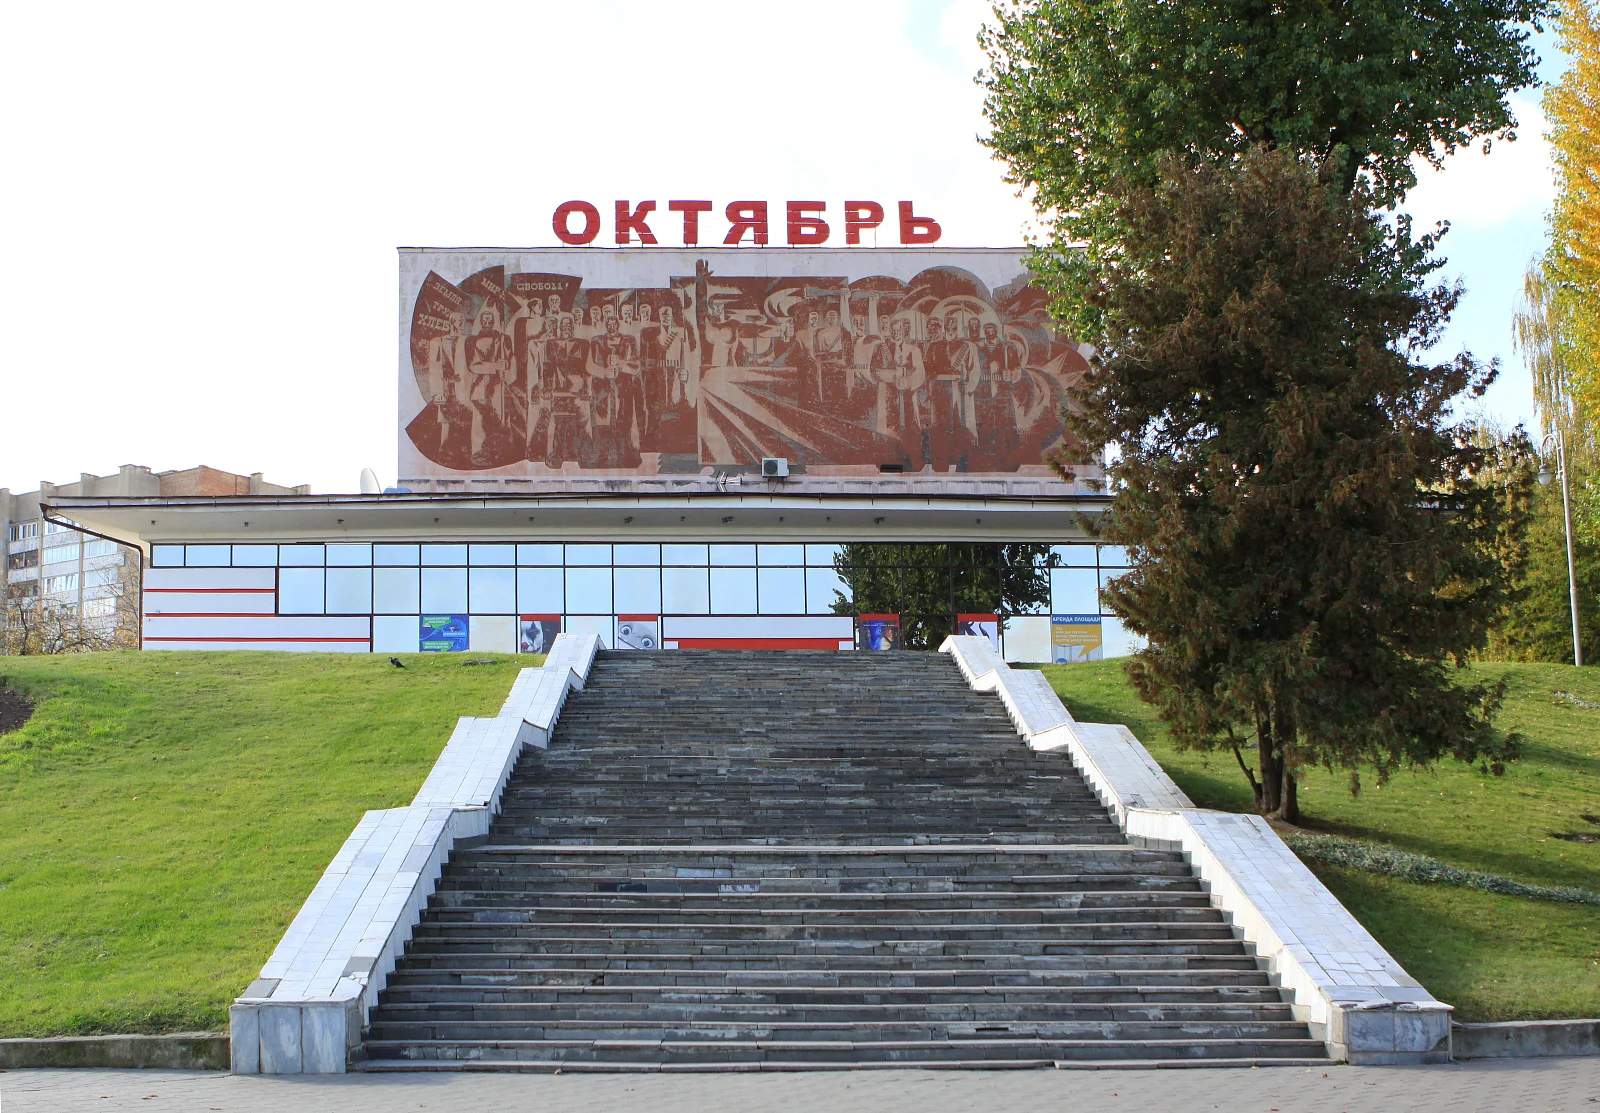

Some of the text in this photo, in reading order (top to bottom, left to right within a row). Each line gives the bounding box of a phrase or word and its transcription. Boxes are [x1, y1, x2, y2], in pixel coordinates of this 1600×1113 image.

[552, 200, 942, 245] ОКТЯБРЬ
[433, 281, 462, 305] ЗЕМЛЯ
[516, 282, 569, 292] СВОБОДА!
[433, 301, 451, 316] ТРУ
